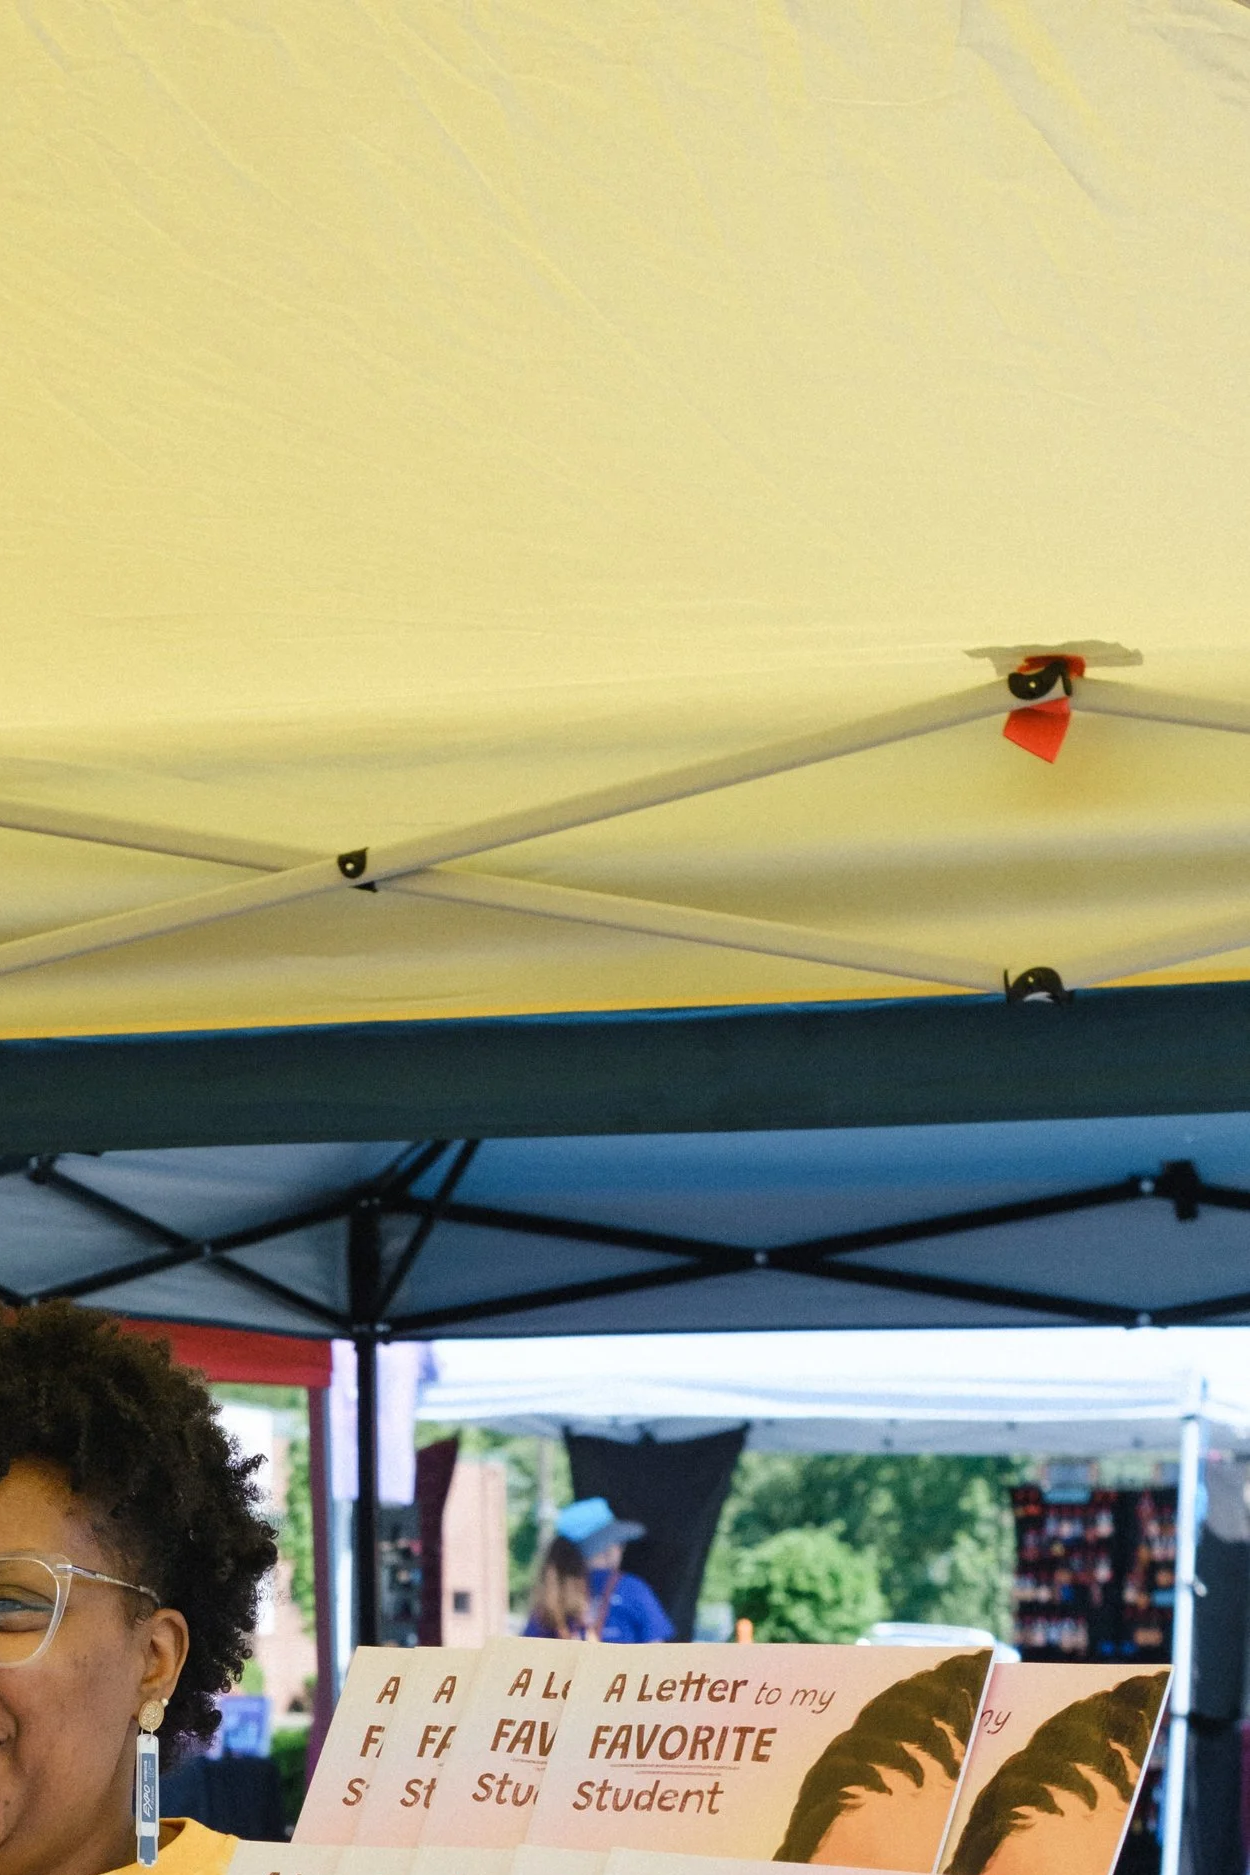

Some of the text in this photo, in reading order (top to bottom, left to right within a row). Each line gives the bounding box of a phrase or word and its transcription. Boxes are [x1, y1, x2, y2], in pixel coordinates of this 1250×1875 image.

[603, 1671, 836, 1714] A Letter to my
[588, 1724, 777, 1762] FAVORITE
[572, 1779, 724, 1814] Student
